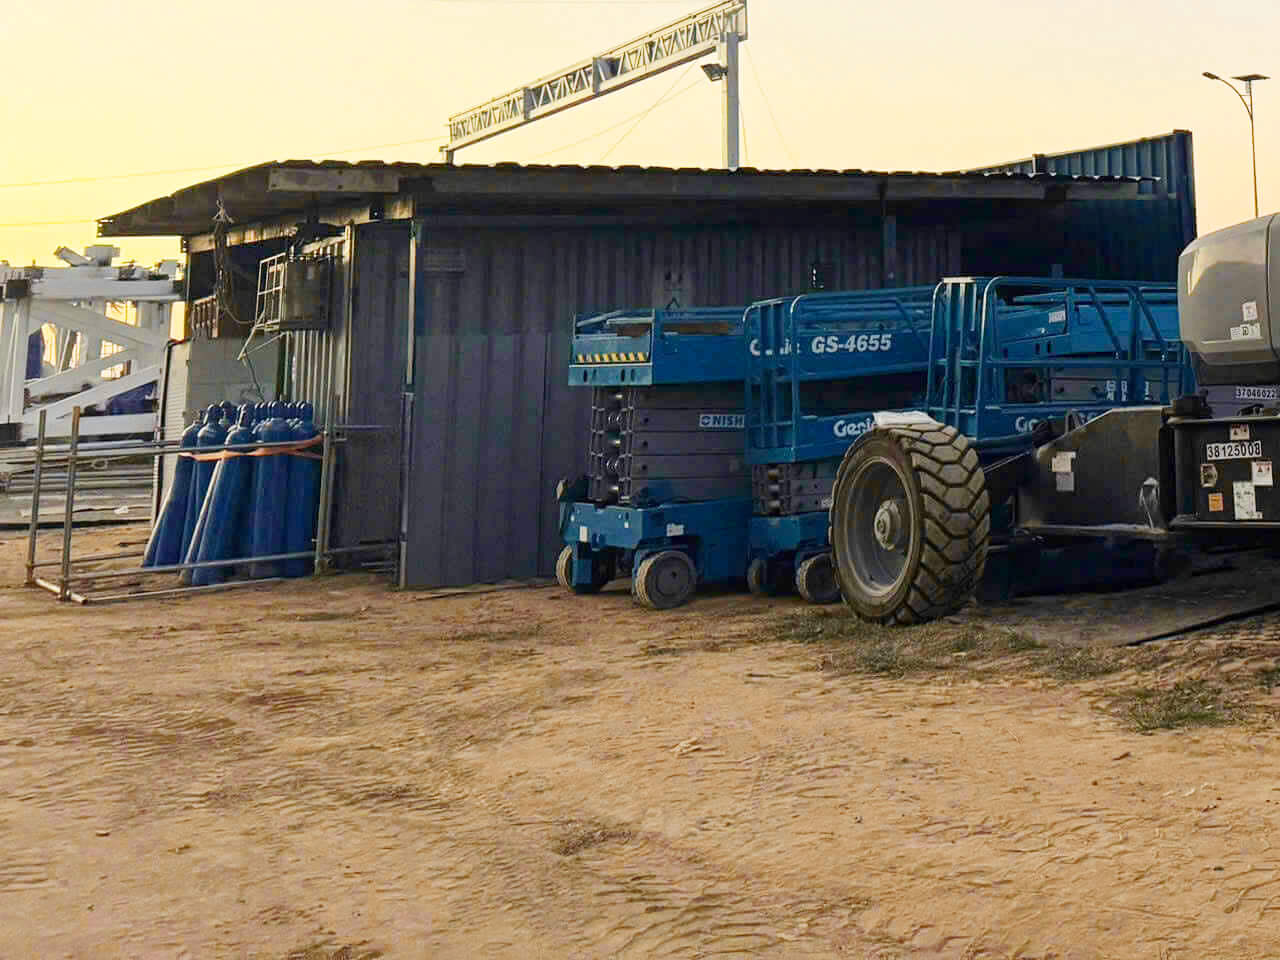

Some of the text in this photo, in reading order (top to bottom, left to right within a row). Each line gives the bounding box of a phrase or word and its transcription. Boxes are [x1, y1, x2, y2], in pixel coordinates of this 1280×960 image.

[811, 334, 892, 354] GS-4655
[712, 415, 744, 427] NISH
[833, 417, 873, 438] Geni
[1207, 441, 1261, 458] 38125008
